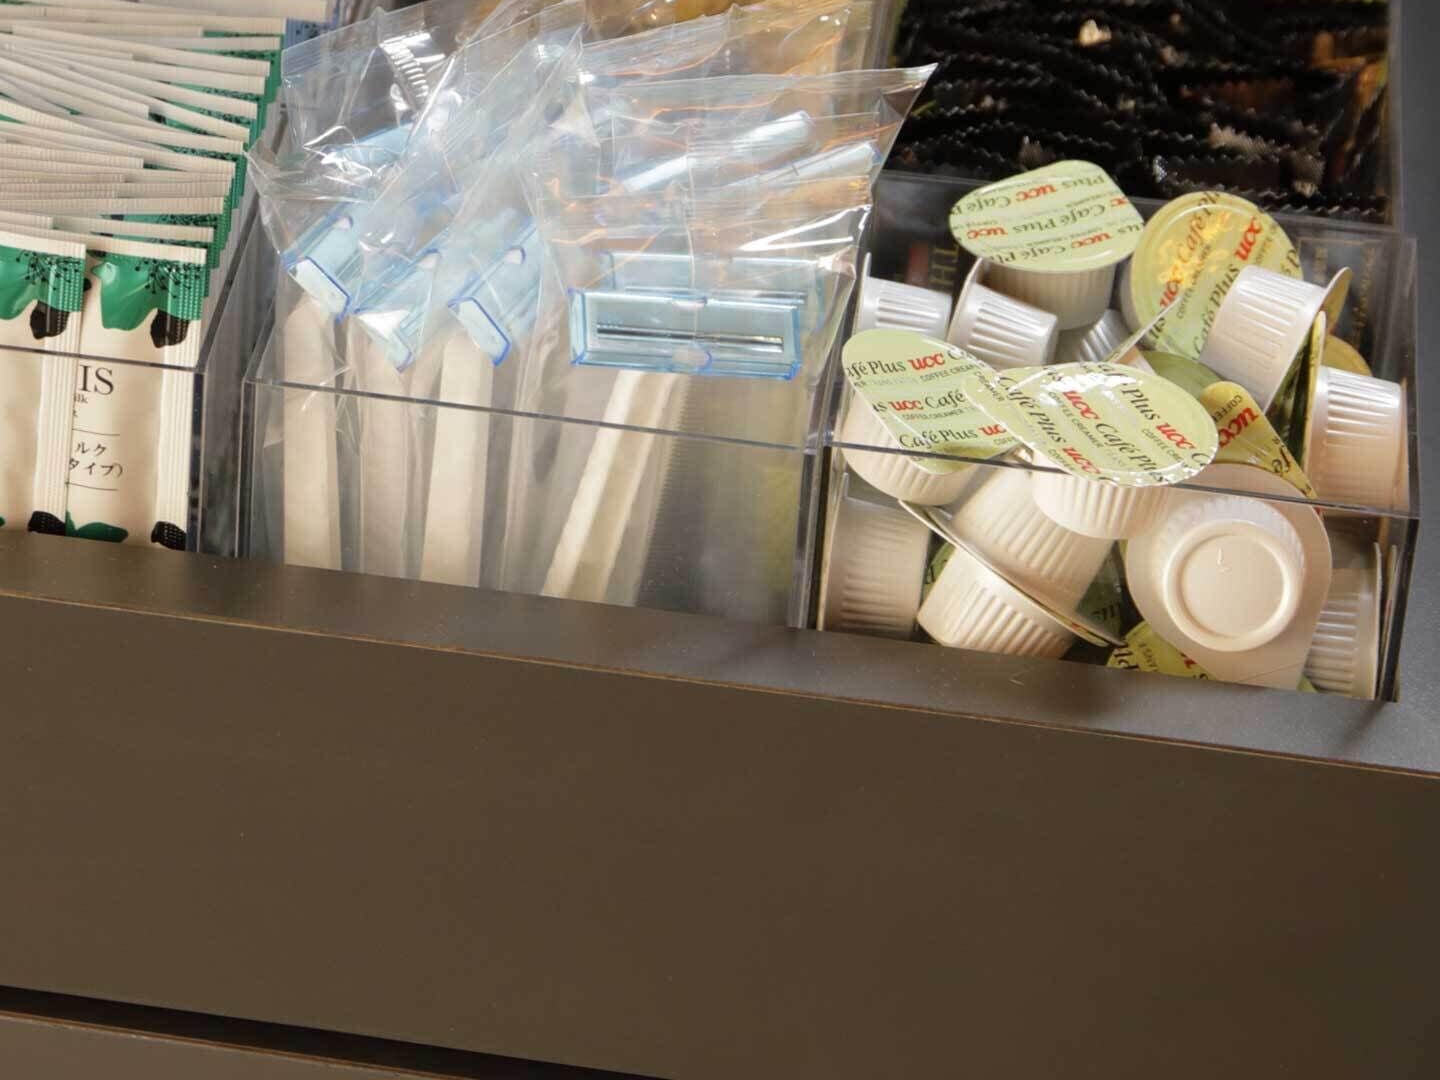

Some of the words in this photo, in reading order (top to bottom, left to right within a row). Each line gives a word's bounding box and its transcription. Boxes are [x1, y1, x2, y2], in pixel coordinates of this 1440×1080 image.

[1013, 218, 1057, 235] Plus
[1209, 263, 1241, 308] Plus
[79, 364, 114, 396] IS
[867, 360, 907, 375] Plus
[924, 389, 966, 408] Café
[1121, 383, 1160, 421] Plus
[898, 431, 938, 449] Café
[938, 428, 979, 441] Plus
[1027, 410, 1067, 443] Plus
[1095, 422, 1136, 455] Café
